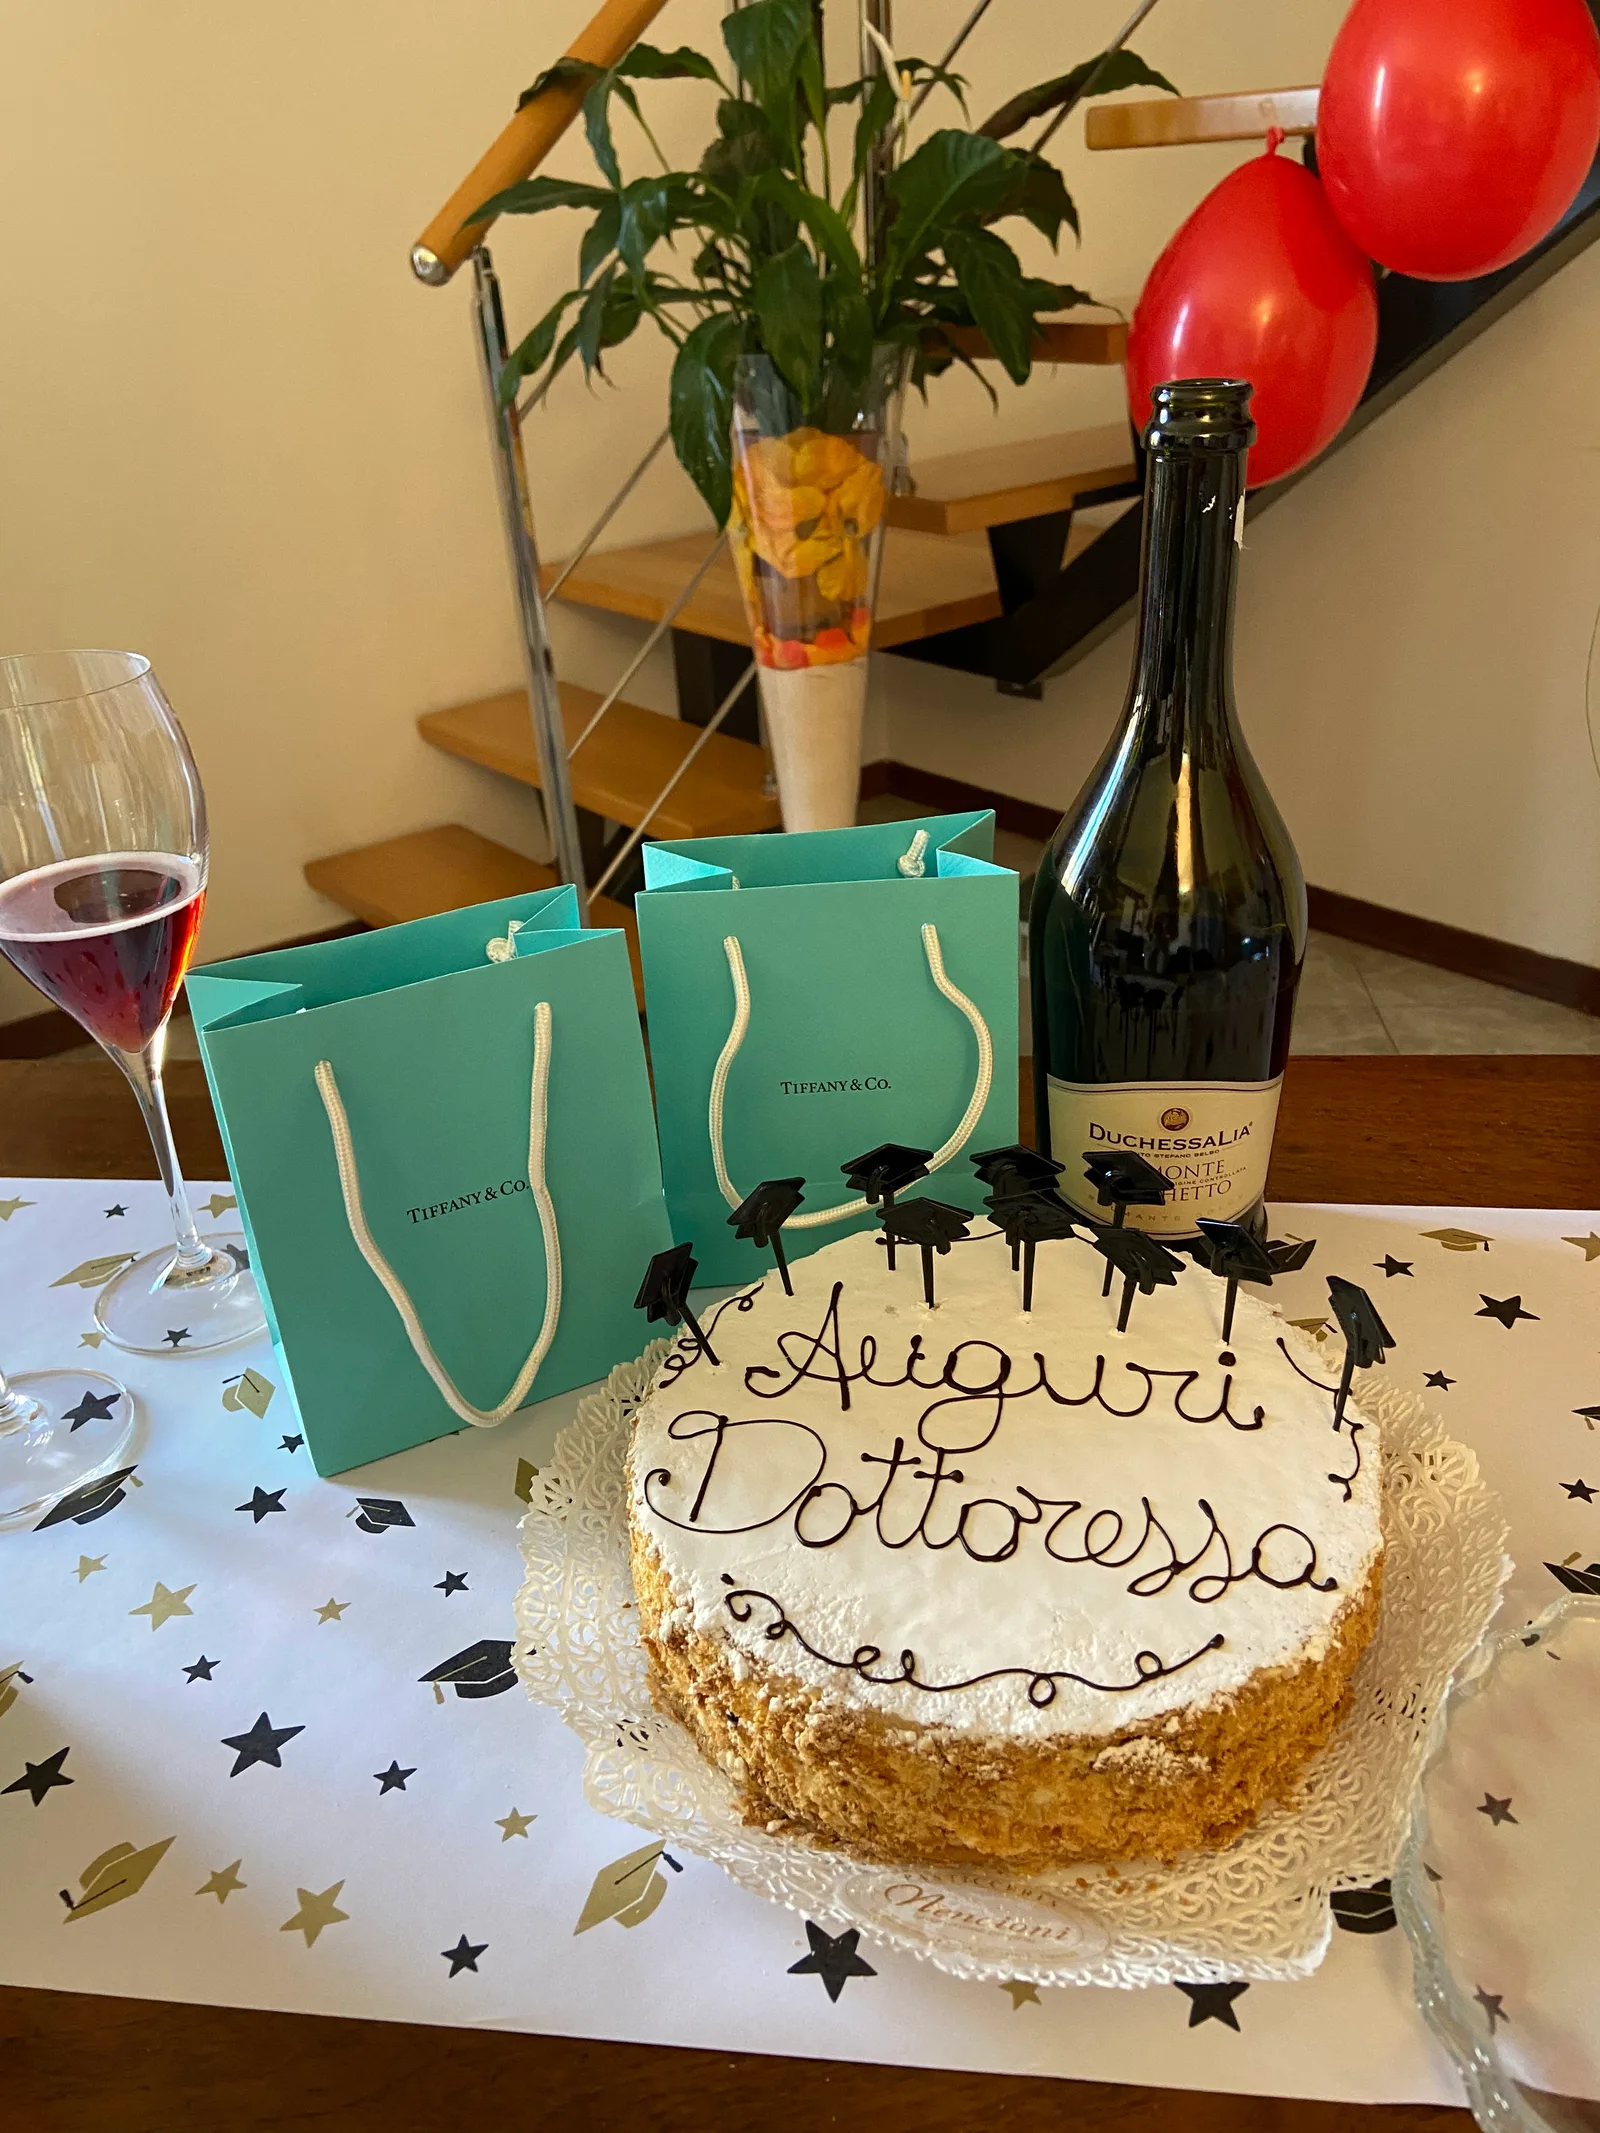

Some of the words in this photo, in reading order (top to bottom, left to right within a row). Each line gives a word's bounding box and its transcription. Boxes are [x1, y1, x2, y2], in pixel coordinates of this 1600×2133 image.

[1088, 1121, 1252, 1150] DUCHESSALIA
[745, 1281, 1264, 1453] Auguri
[644, 1409, 1340, 1604] Dottoressa
